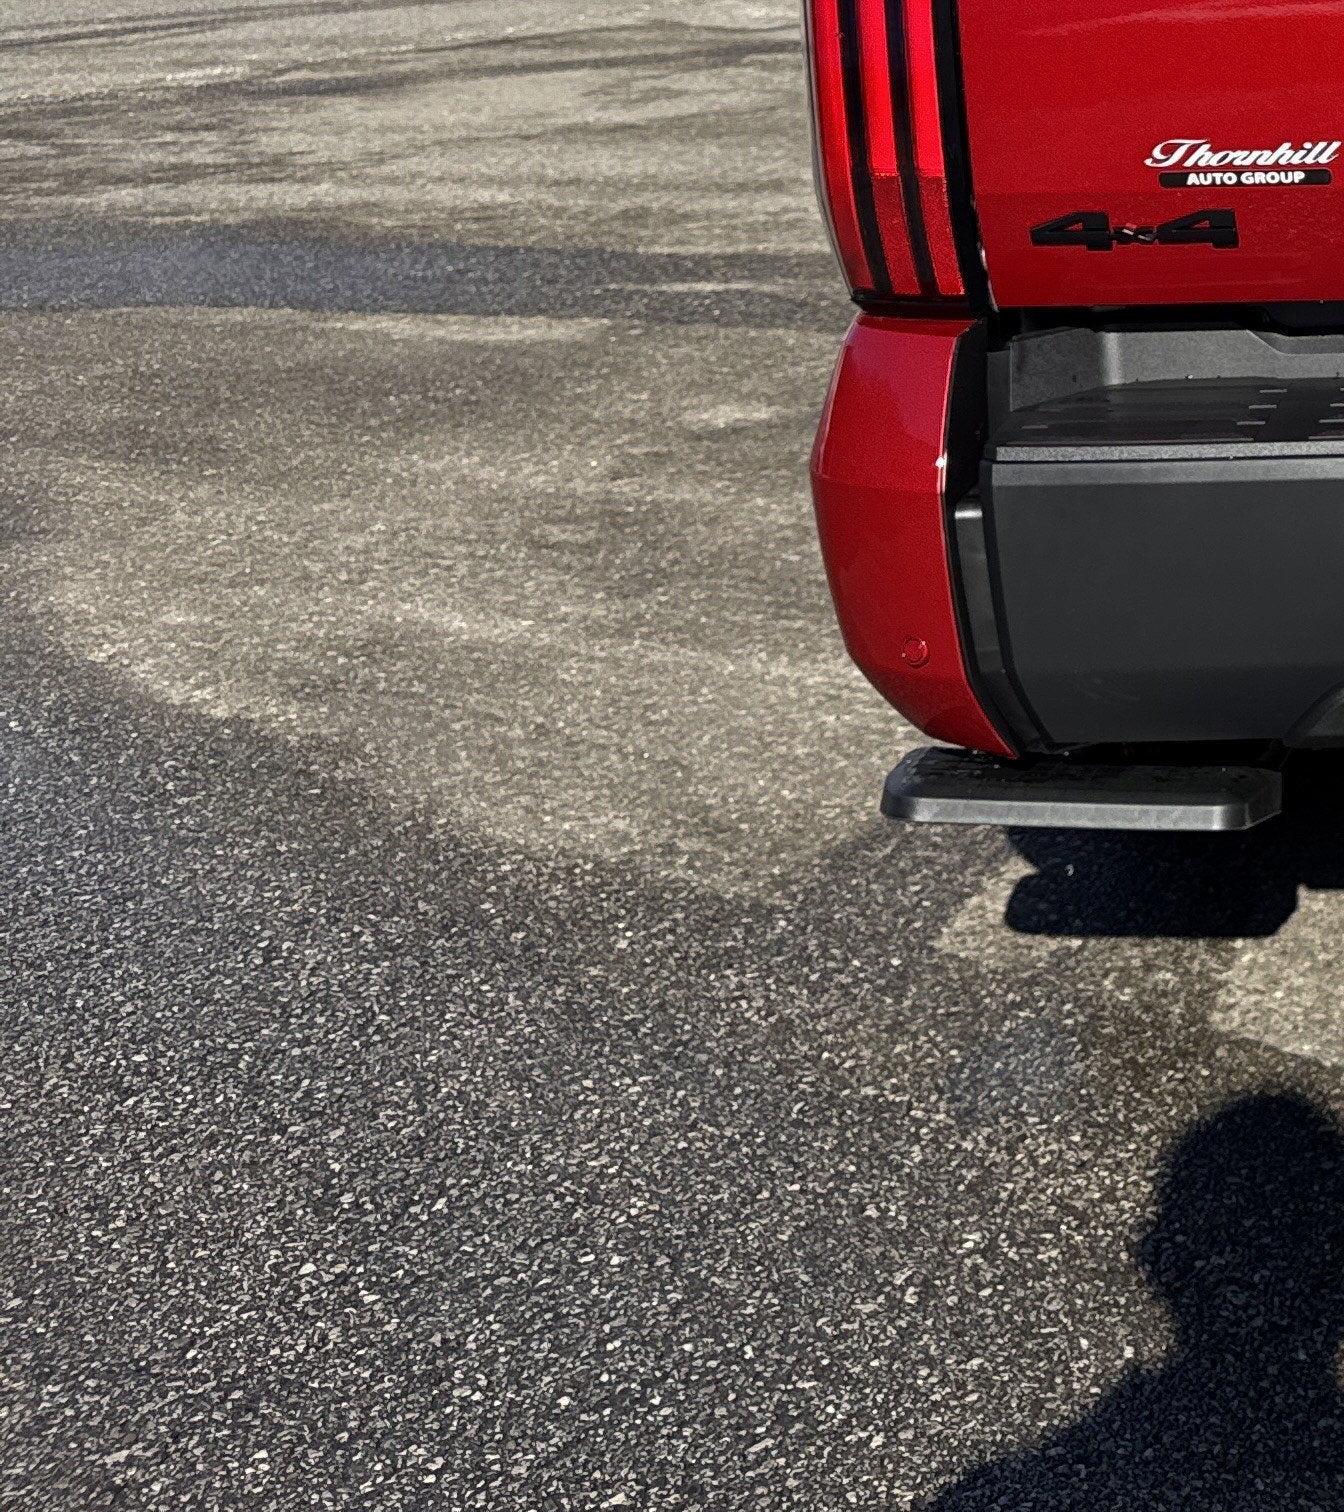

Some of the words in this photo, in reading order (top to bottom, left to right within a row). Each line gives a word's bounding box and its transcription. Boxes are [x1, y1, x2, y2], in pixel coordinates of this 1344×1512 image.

[1143, 138, 1342, 168] Thornhill
[1186, 172, 1237, 186] AUTO
[1240, 170, 1306, 185] GROUP
